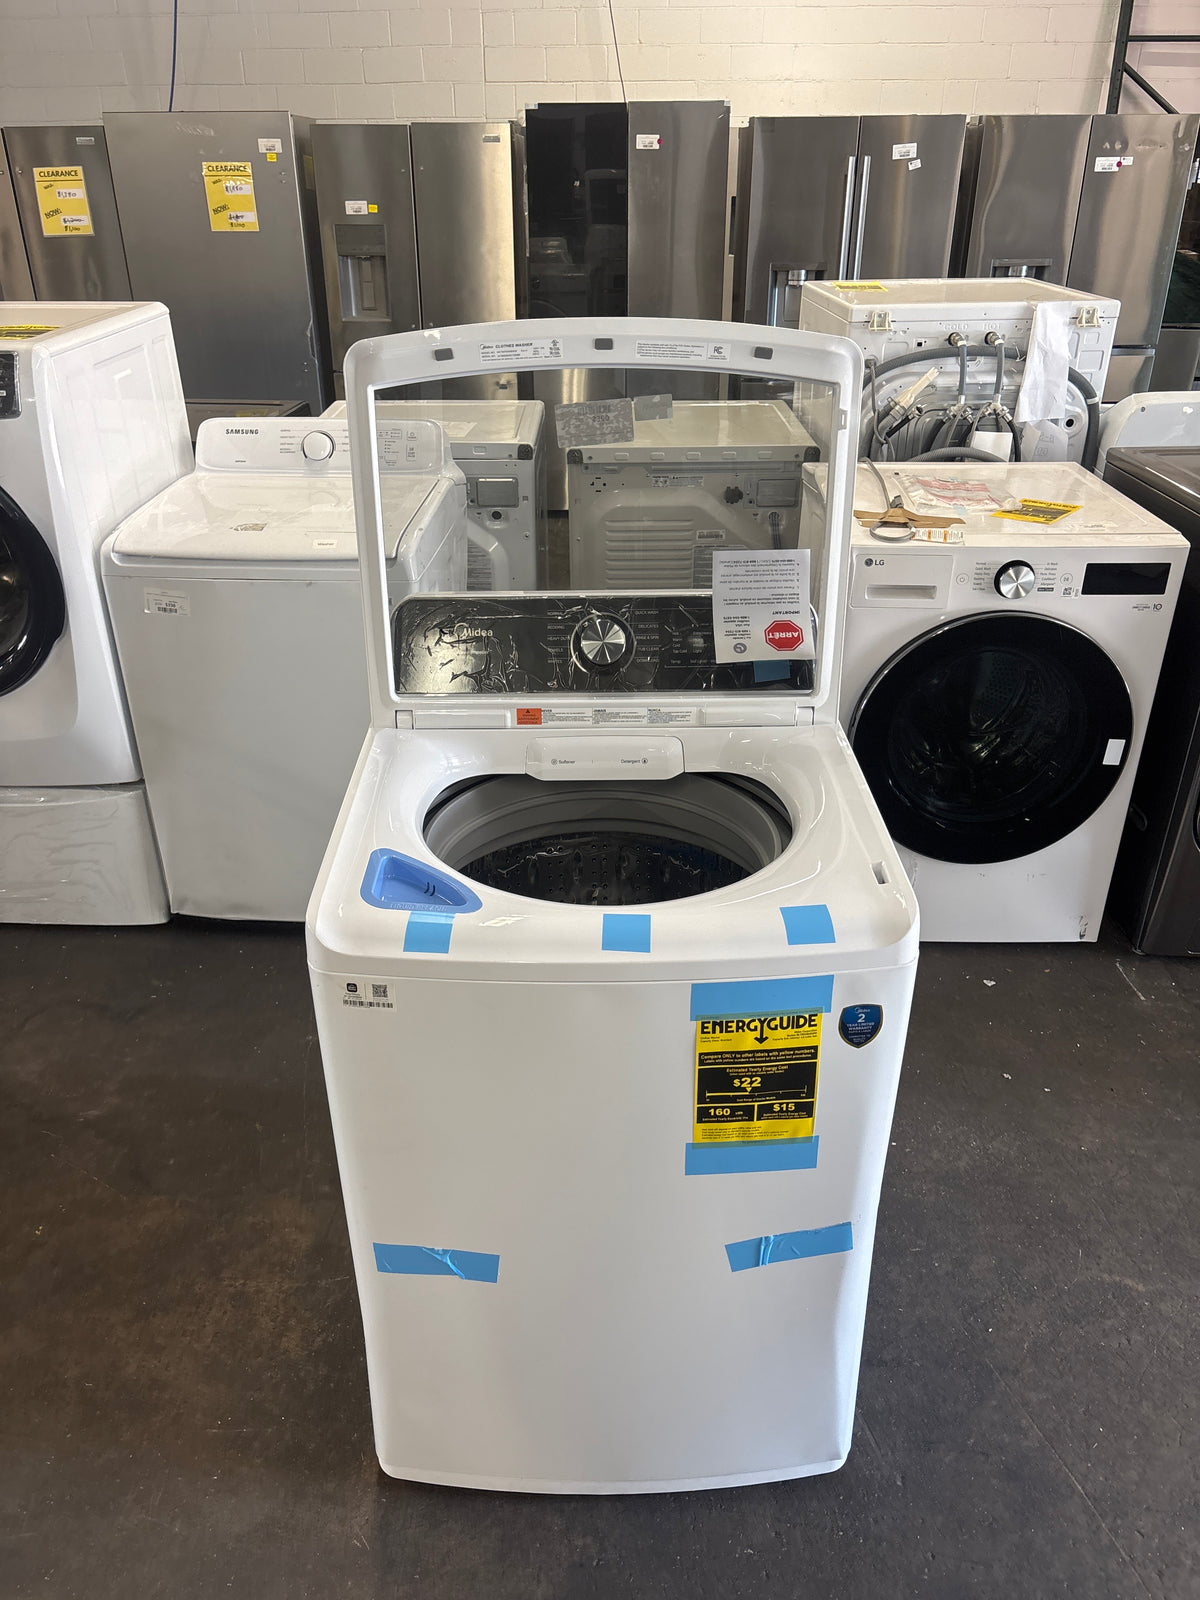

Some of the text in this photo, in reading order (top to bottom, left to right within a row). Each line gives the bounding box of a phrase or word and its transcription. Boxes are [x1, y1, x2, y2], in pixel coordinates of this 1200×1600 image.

[456, 624, 493, 638] Midea
[857, 1013, 865, 1022] 2
[700, 1014, 818, 1035] ENERGYGUIDE
[733, 1077, 761, 1087] $22
[773, 1103, 795, 1112] $15
